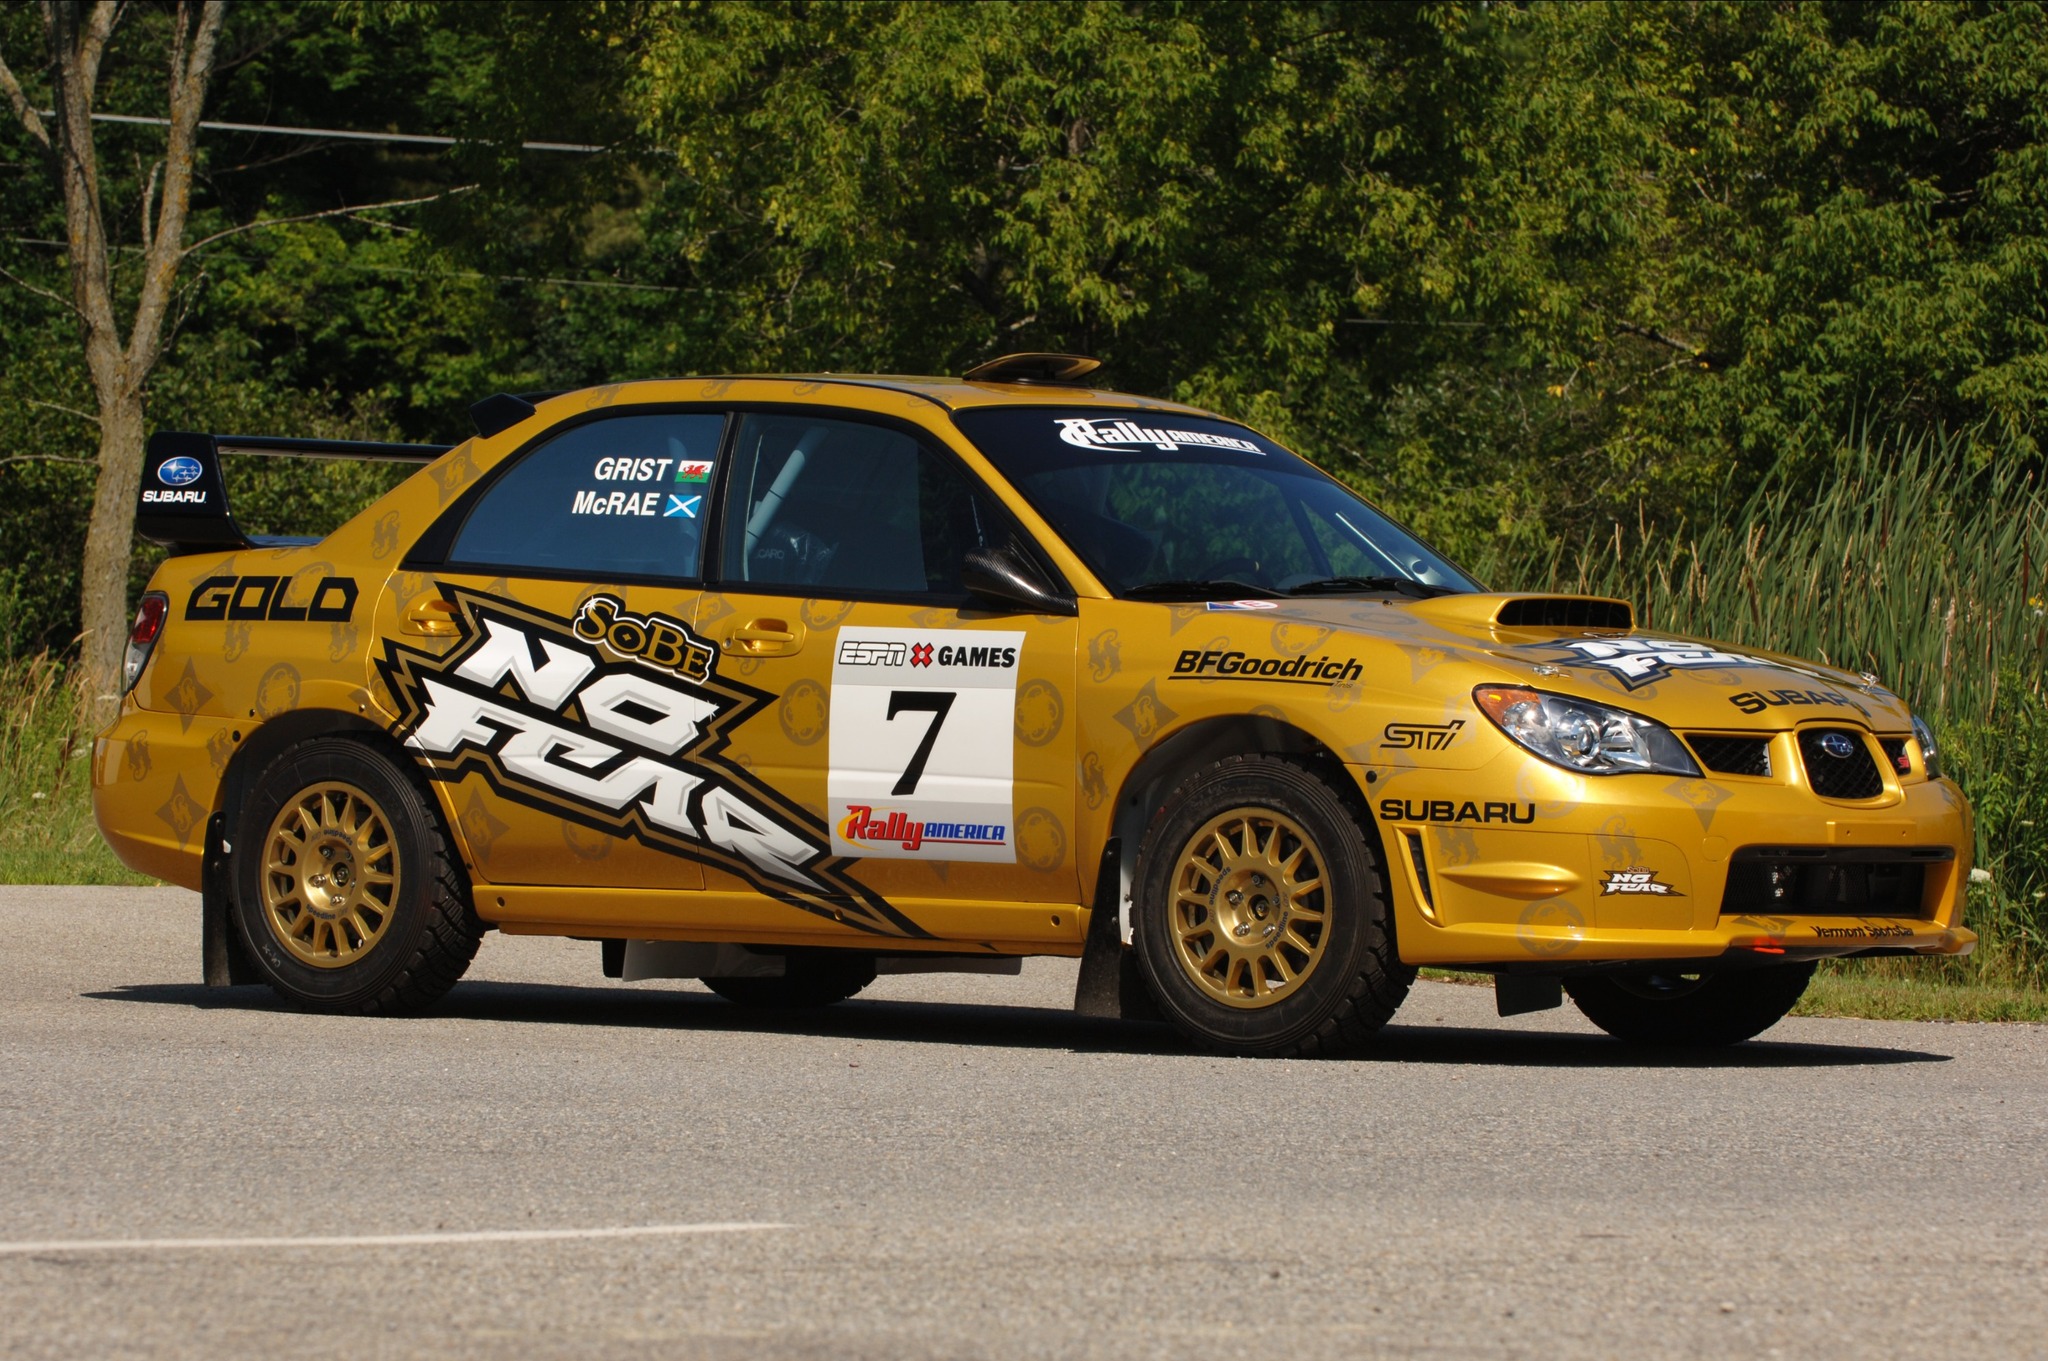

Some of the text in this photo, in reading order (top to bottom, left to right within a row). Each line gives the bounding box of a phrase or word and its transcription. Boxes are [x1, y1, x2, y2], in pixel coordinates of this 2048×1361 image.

[1054, 418, 1262, 453] Rally AMERICA
[594, 457, 673, 482] GRIST
[142, 490, 207, 503] SUBARU
[572, 491, 660, 516] McRAE
[185, 575, 359, 622] GOLD
[838, 641, 907, 667] ESPN
[938, 645, 1016, 668] GAMES
[1565, 640, 1717, 658] NO
[1173, 650, 1364, 681] BFGoodrich
[454, 618, 709, 756] NO
[886, 690, 957, 796] 7
[404, 676, 831, 894] FEAR
[1380, 799, 1535, 824] SUBARU
[845, 805, 1006, 850] Rally AMERICA
[1208, 866, 1231, 906] speedline
[1606, 883, 1669, 894] FEAR
[1611, 873, 1652, 883] NO
[1265, 911, 1289, 949] speedline
[1810, 925, 1866, 938] Vermont
